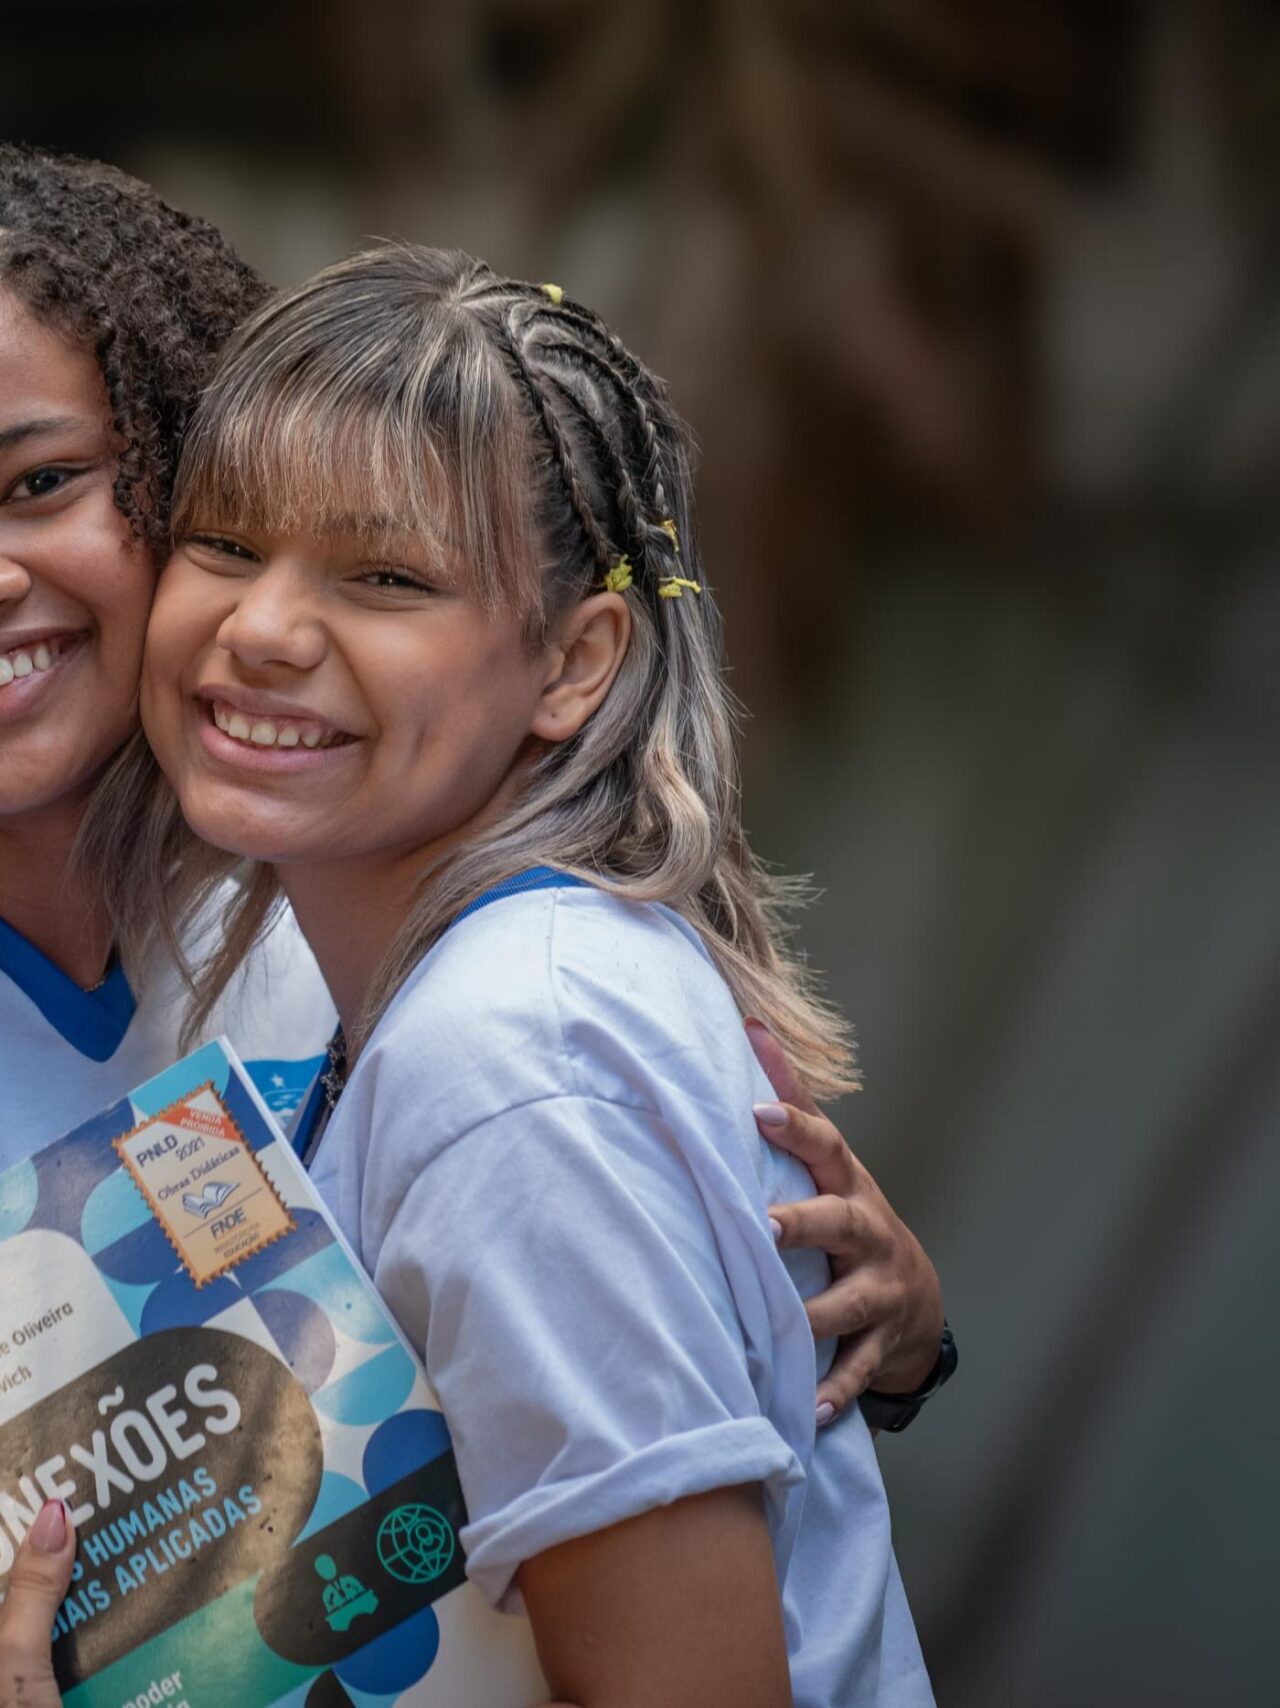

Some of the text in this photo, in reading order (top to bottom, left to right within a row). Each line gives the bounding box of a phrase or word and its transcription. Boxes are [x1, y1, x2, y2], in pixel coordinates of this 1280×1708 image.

[136, 1133, 178, 1168] PNLD
[175, 1135, 206, 1161] 2021
[157, 1145, 240, 1201] Obras Didáticas
[210, 1207, 246, 1240] FNDE
[12, 1301, 74, 1346] Oliveira
[83, 1466, 217, 1567] HUMANAS
[114, 1484, 263, 1597] APLICADAS
